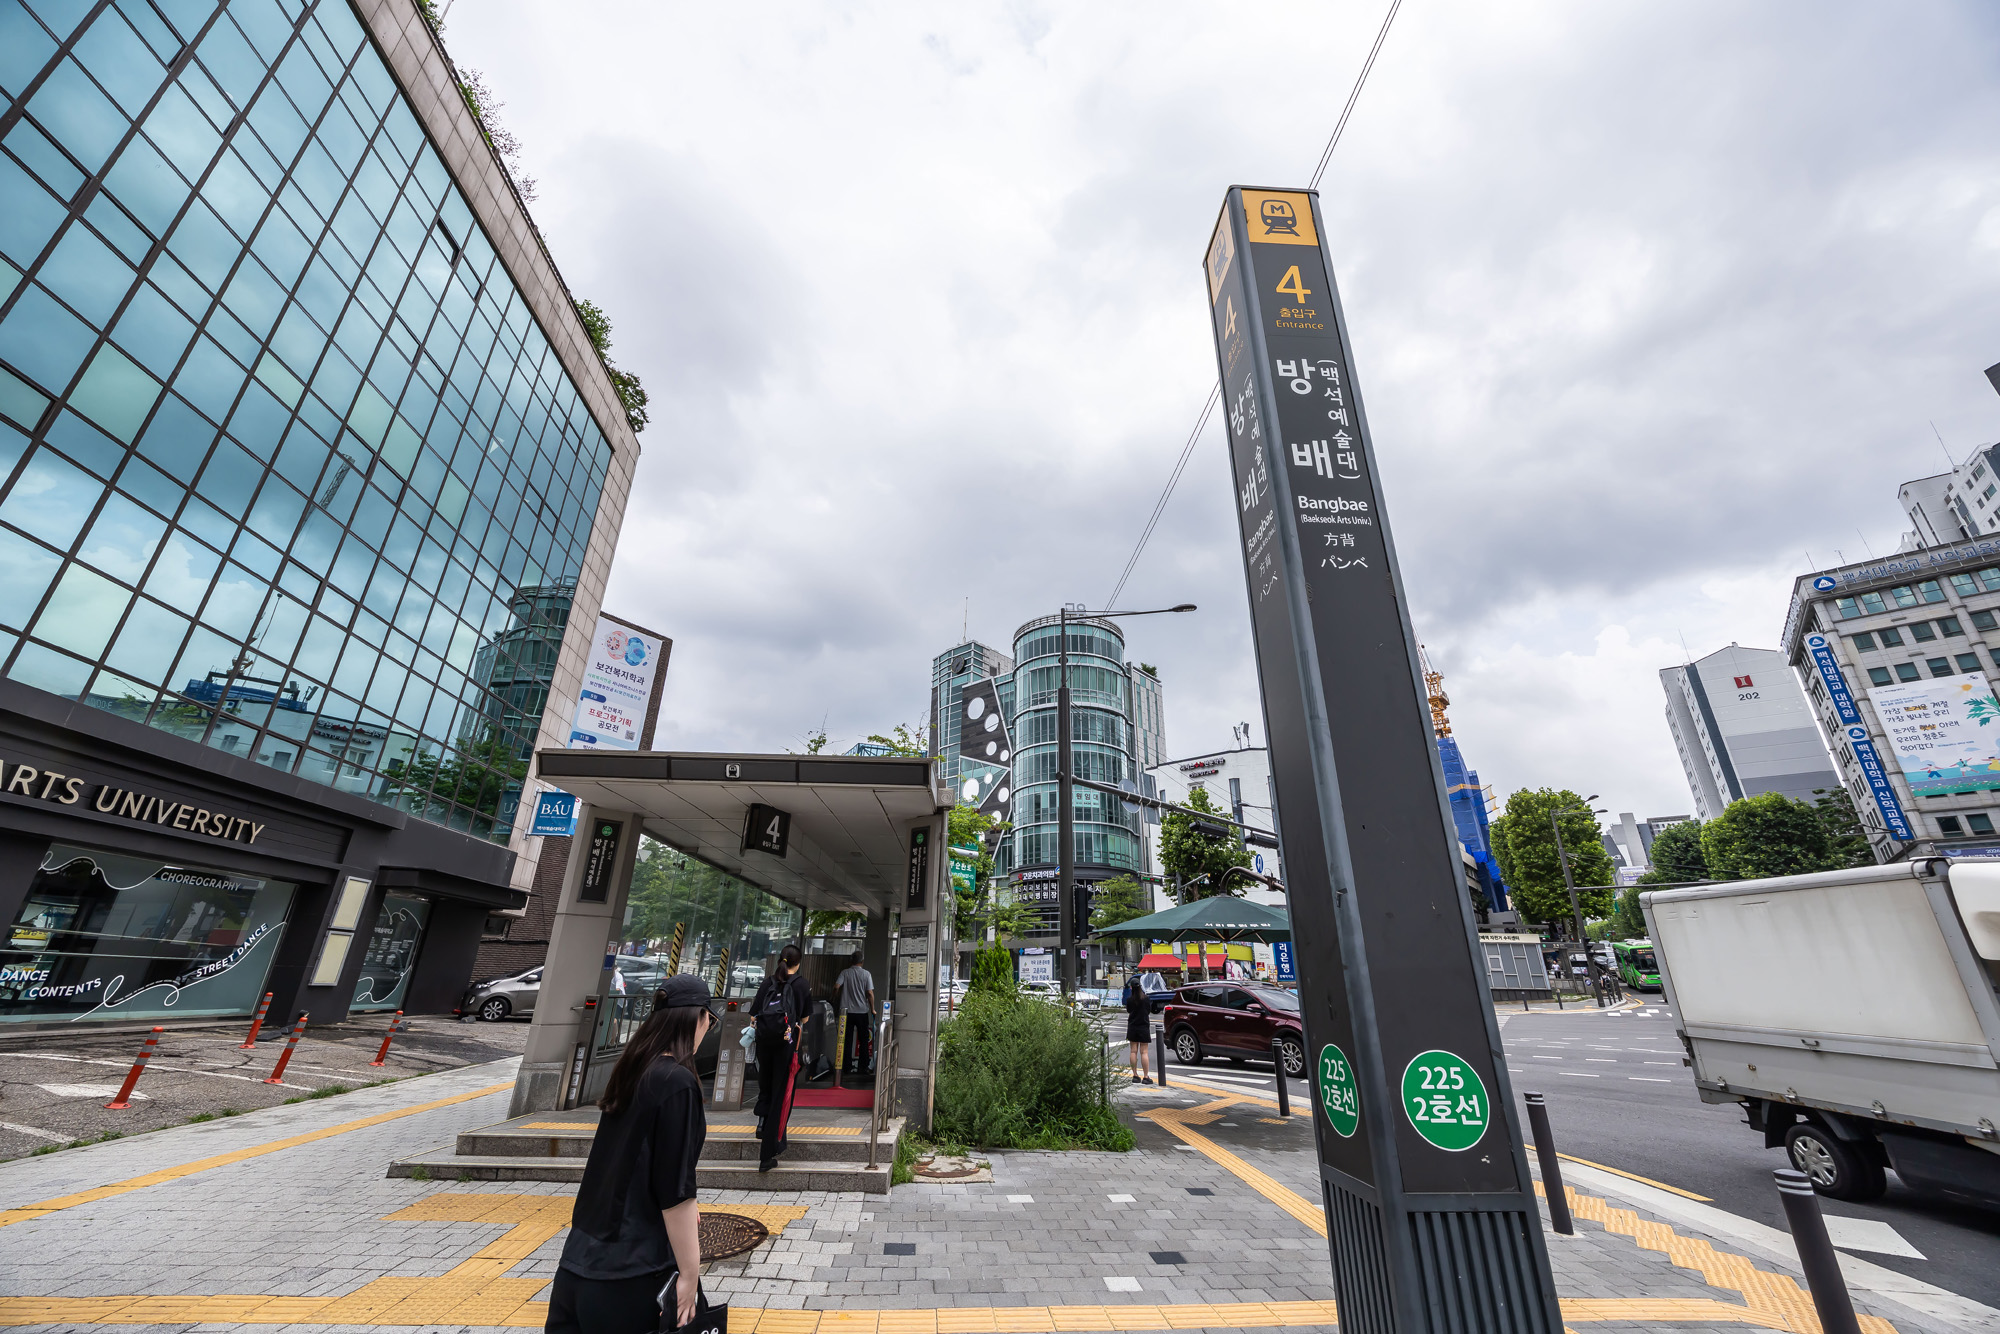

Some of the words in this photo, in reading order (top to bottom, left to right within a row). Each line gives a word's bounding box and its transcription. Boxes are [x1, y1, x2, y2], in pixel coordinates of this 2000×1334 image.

[1275, 265, 1312, 304] 4
[1224, 294, 1238, 341] 4
[1279, 307, 1317, 319] 출입구
[1275, 319, 1324, 330] Entrance
[1297, 495, 1368, 514] Bangbae
[1300, 513, 1336, 524] (Baekseok
[1337, 515, 1352, 525] Arts
[1352, 516, 1372, 527] Univ.)
[1247, 509, 1274, 553] Bangbae
[1323, 532, 1355, 547] 方背
[1841, 557, 1921, 584] 백석대학교
[595, 661, 645, 686] 보건복지학과
[1816, 651, 1843, 690] 백석대학교
[1834, 691, 1855, 718] 대학원
[1738, 691, 1761, 701] 202
[588, 708, 618, 723] 프로그램
[618, 716, 632, 727] 기획
[1883, 707, 1901, 715] 가장
[1929, 700, 1949, 709] 계절
[1886, 715, 1905, 723] 가장
[1906, 712, 1931, 721] 빛나는
[1933, 708, 1950, 717] 우리
[598, 720, 620, 733] 공모전
[1893, 725, 1918, 734] 뜨거운
[1938, 720, 1960, 729] 아래
[1896, 734, 1921, 743] 우리의
[1922, 731, 1948, 741] 청춘도
[1857, 743, 1887, 788] 백석대학교
[0, 758, 84, 804] RTS
[95, 785, 266, 844] UNIVERSITY
[766, 815, 780, 844] 4
[159, 871, 242, 892] CHOREOGRAPHY
[195, 953, 236, 978] STREET
[236, 922, 269, 957] DANCE
[0, 969, 50, 982] DANCE
[29, 977, 102, 998] CONTENTS
[1324, 1058, 1346, 1082] 225
[1418, 1066, 1464, 1090] 225
[1323, 1084, 1357, 1117] 2호선
[1412, 1094, 1483, 1126] 2호선
